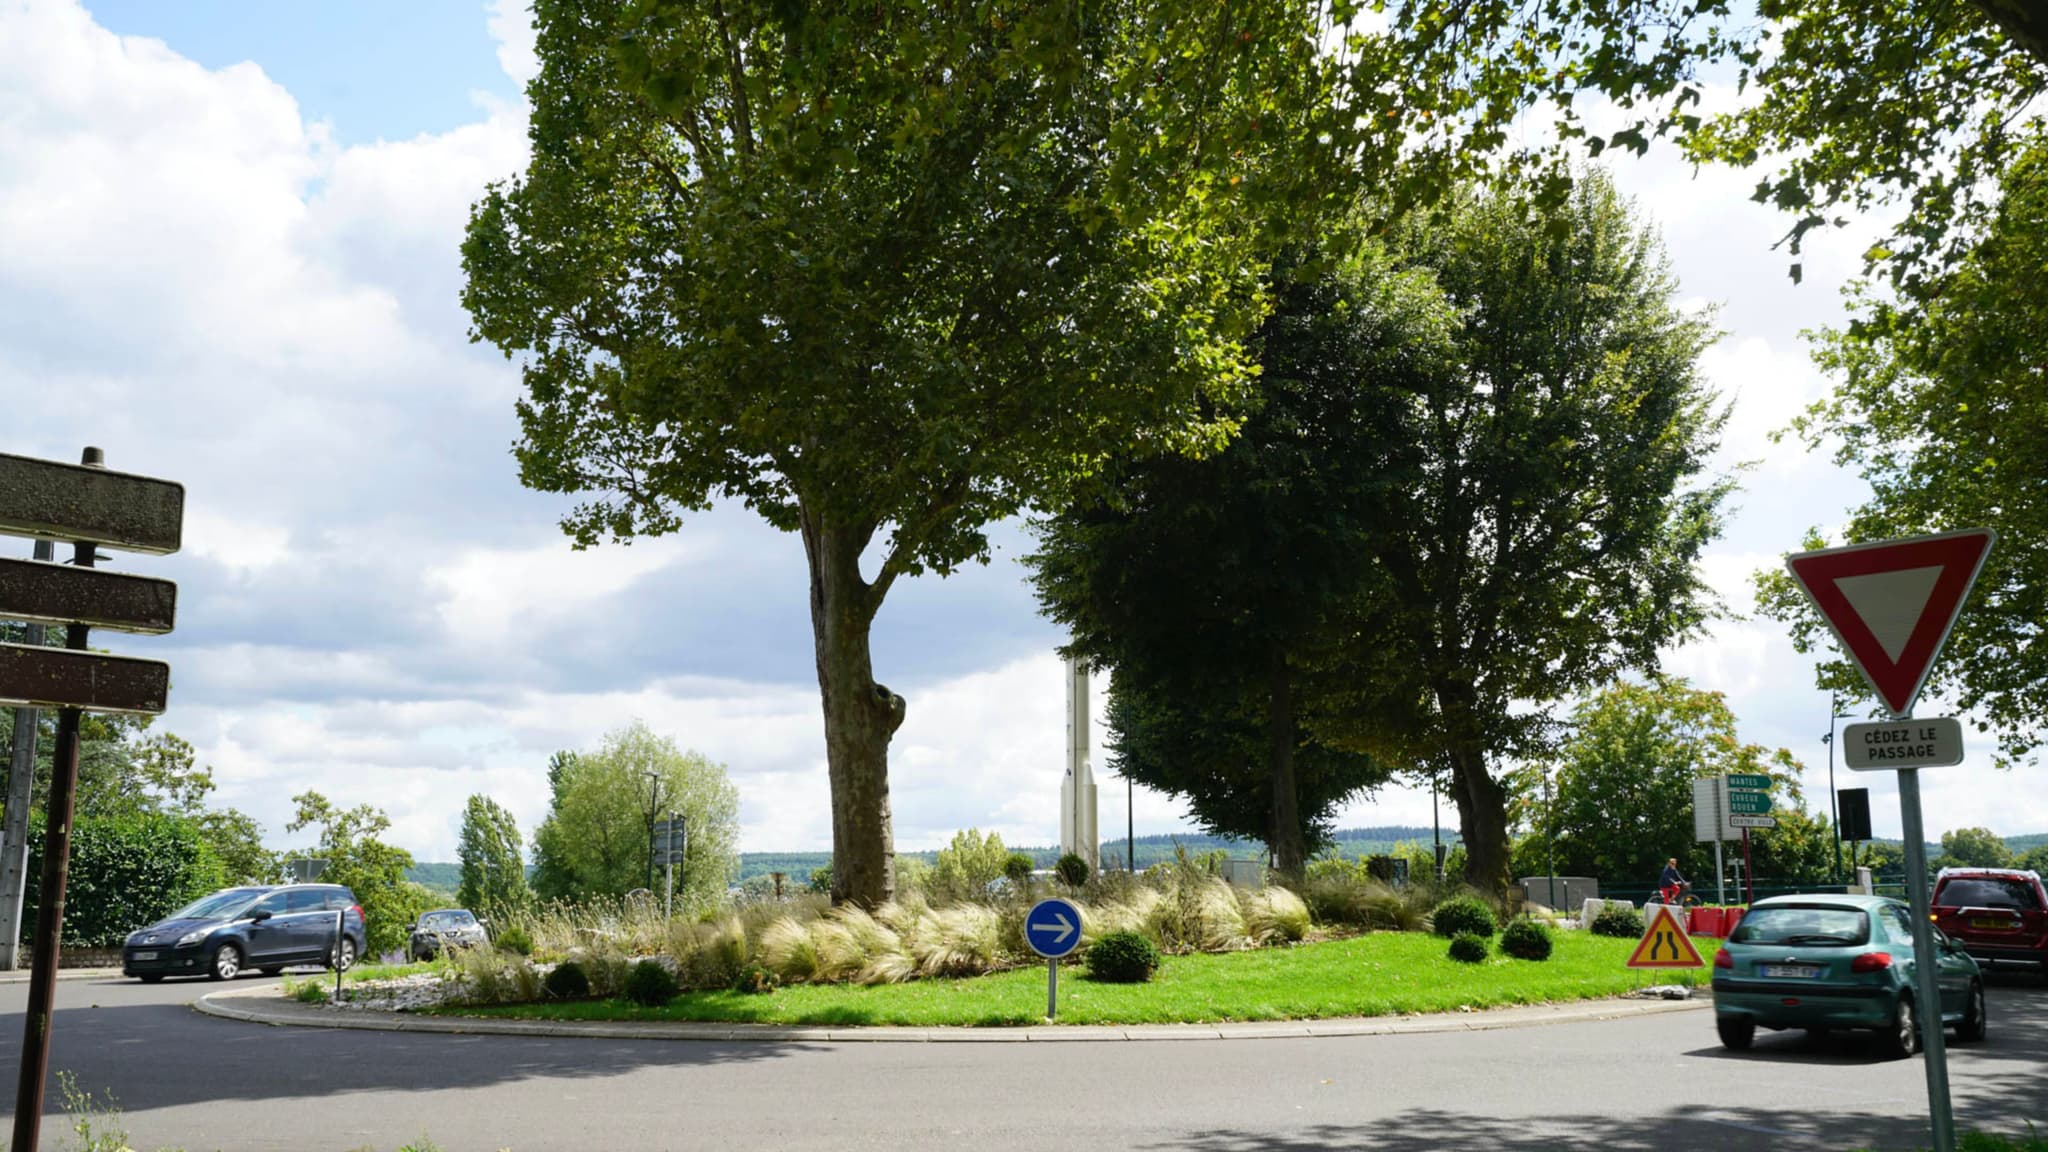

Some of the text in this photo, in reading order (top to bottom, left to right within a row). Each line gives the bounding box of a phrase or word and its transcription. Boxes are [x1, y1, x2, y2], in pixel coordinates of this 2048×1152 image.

[1864, 727, 1937, 744] CÉDEZ LE
[1868, 744, 1936, 760] PASSAGE
[1729, 777, 1759, 787] MANTES
[1731, 803, 1757, 811] ROUEN
